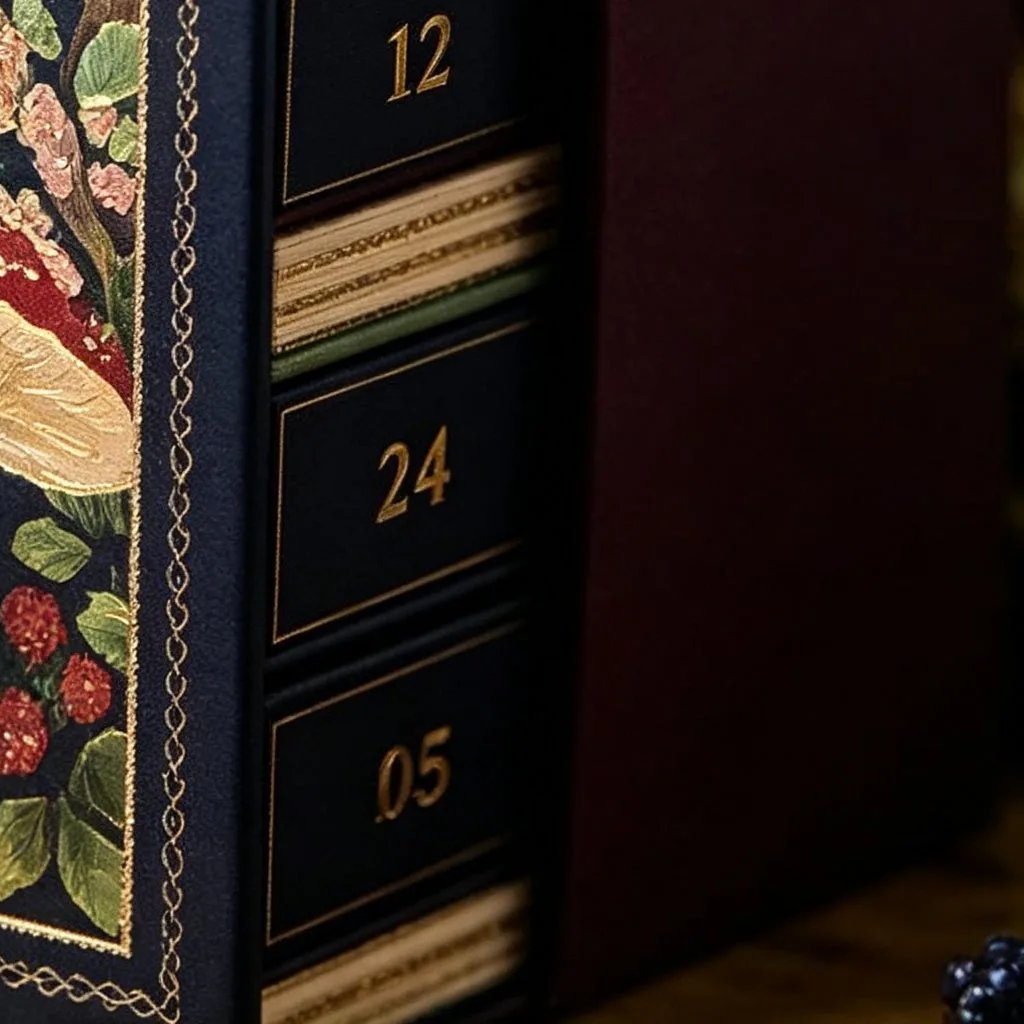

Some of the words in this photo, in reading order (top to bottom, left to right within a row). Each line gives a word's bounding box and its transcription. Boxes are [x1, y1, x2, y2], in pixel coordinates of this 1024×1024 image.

[387, 14, 451, 102] 12
[376, 424, 451, 523] 24
[376, 725, 451, 823] 05
